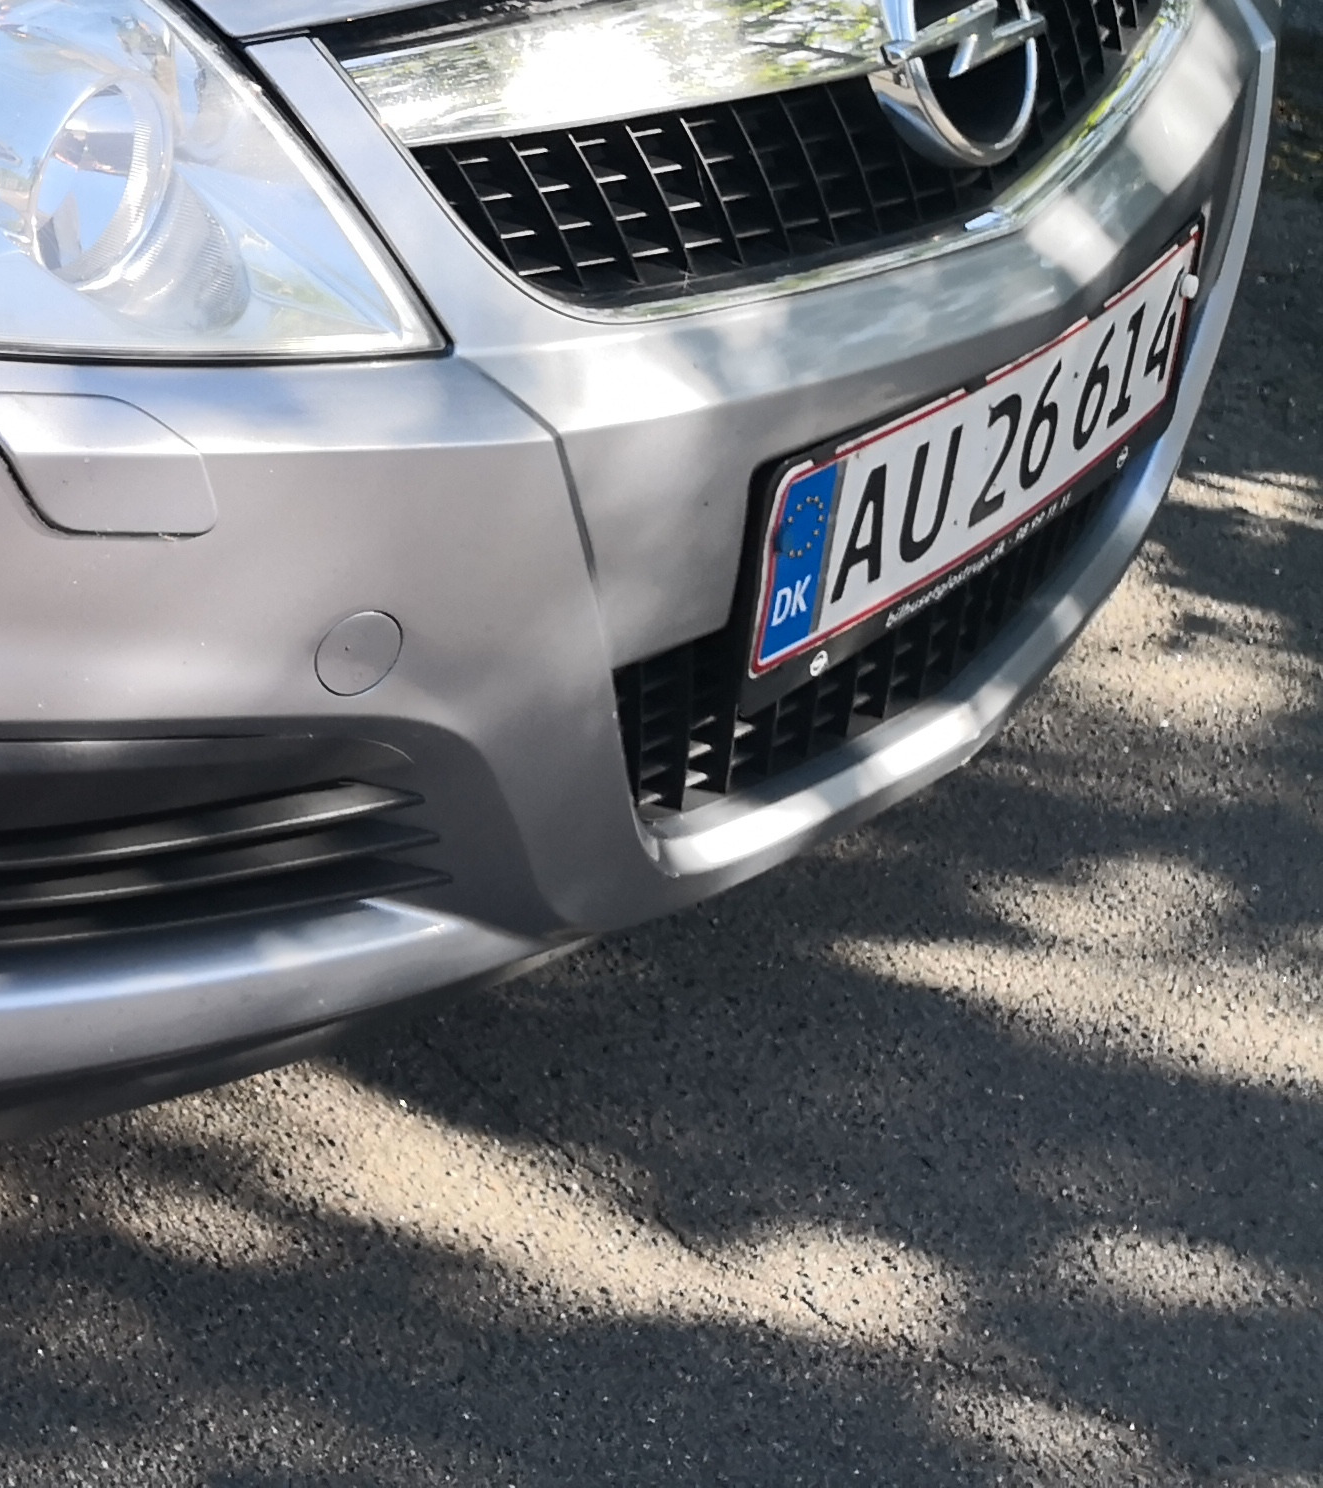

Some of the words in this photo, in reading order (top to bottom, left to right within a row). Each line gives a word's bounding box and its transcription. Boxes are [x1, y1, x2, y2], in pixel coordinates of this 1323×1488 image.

[830, 424, 963, 604] AU
[968, 359, 1062, 529] 26
[1073, 266, 1185, 451] 614
[771, 574, 812, 627] DK
